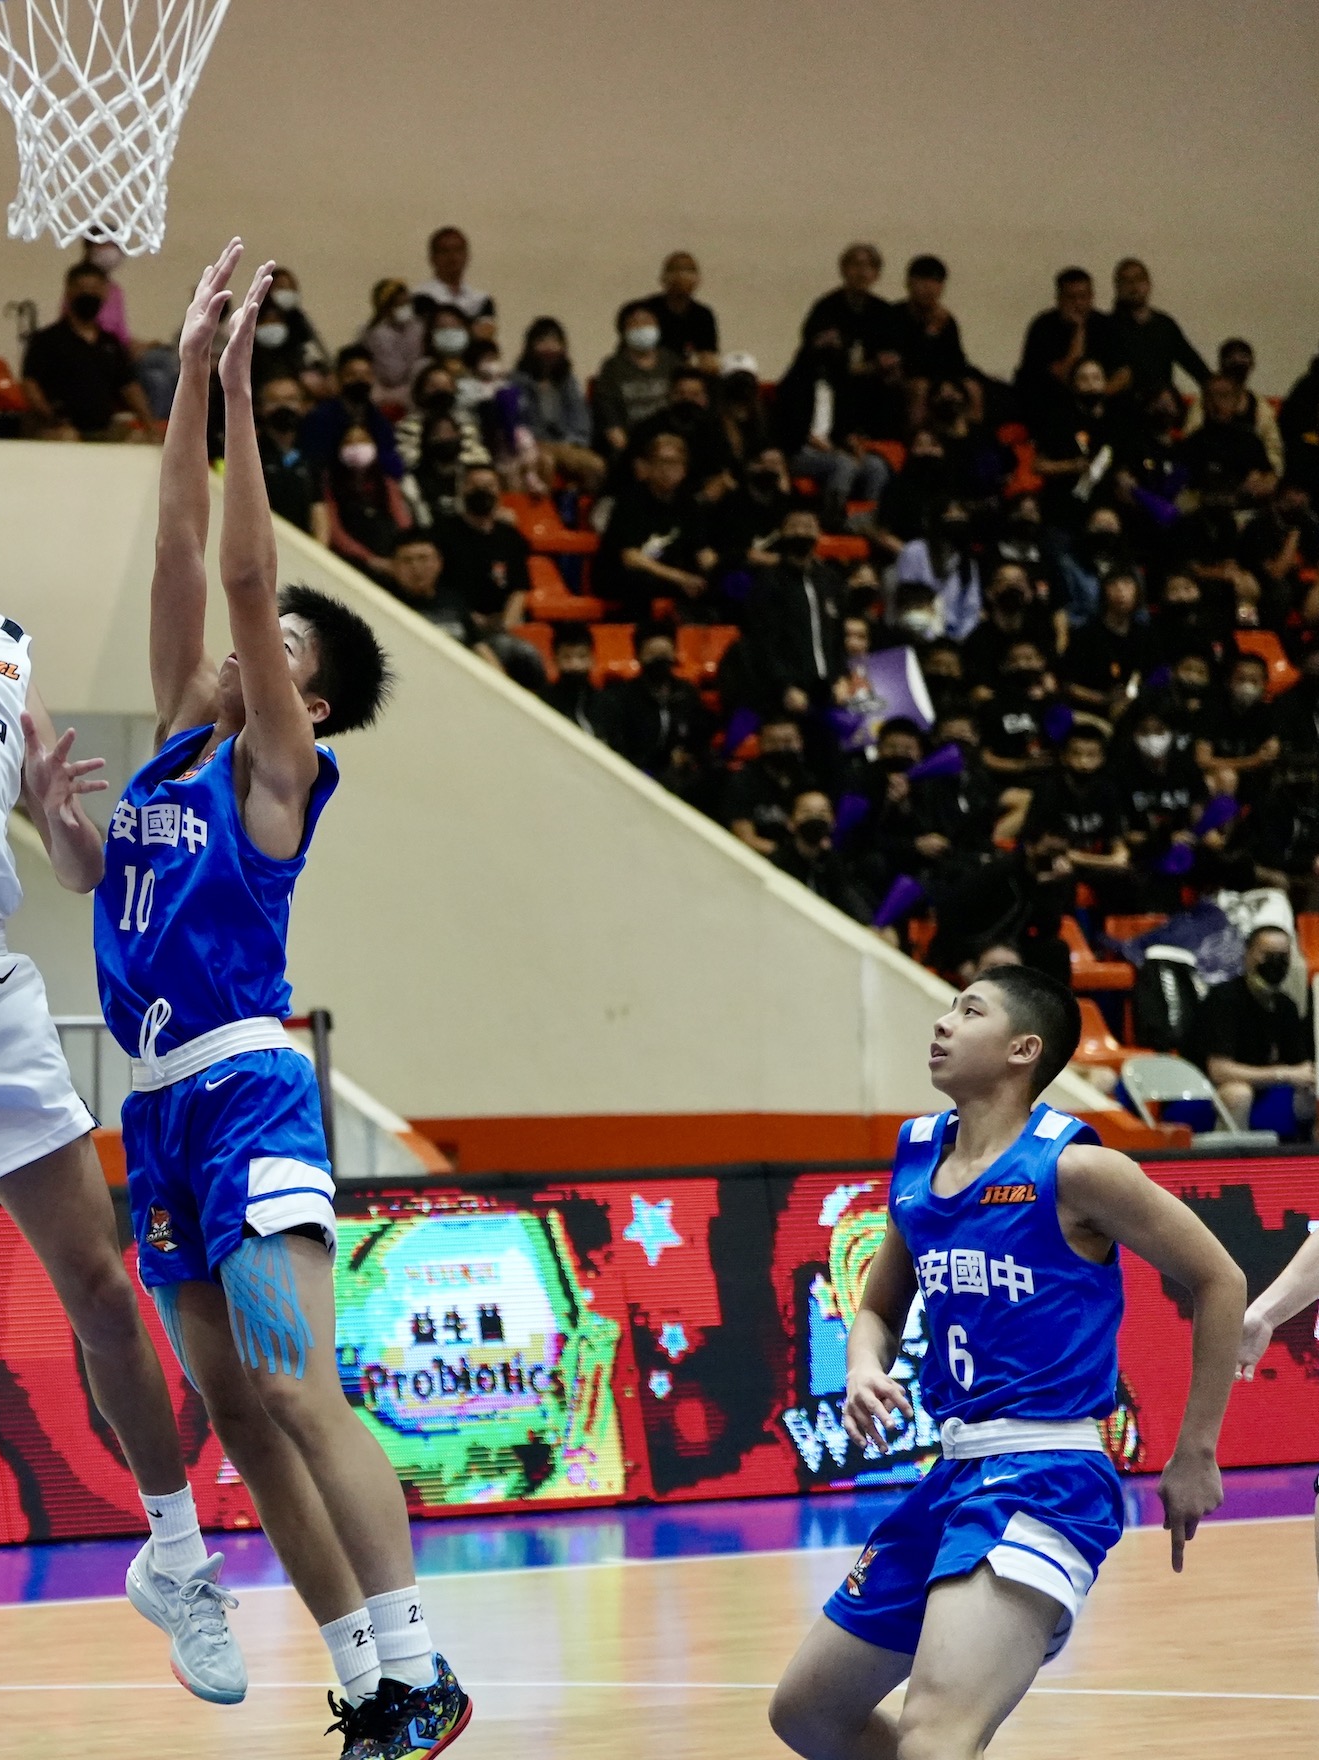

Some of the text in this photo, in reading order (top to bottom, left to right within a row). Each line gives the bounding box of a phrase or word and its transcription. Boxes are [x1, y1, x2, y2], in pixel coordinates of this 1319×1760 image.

[111, 799, 208, 854] 安國中
[119, 865, 156, 936] 10
[915, 1249, 1035, 1303] 安國中
[947, 1325, 974, 1391] 6
